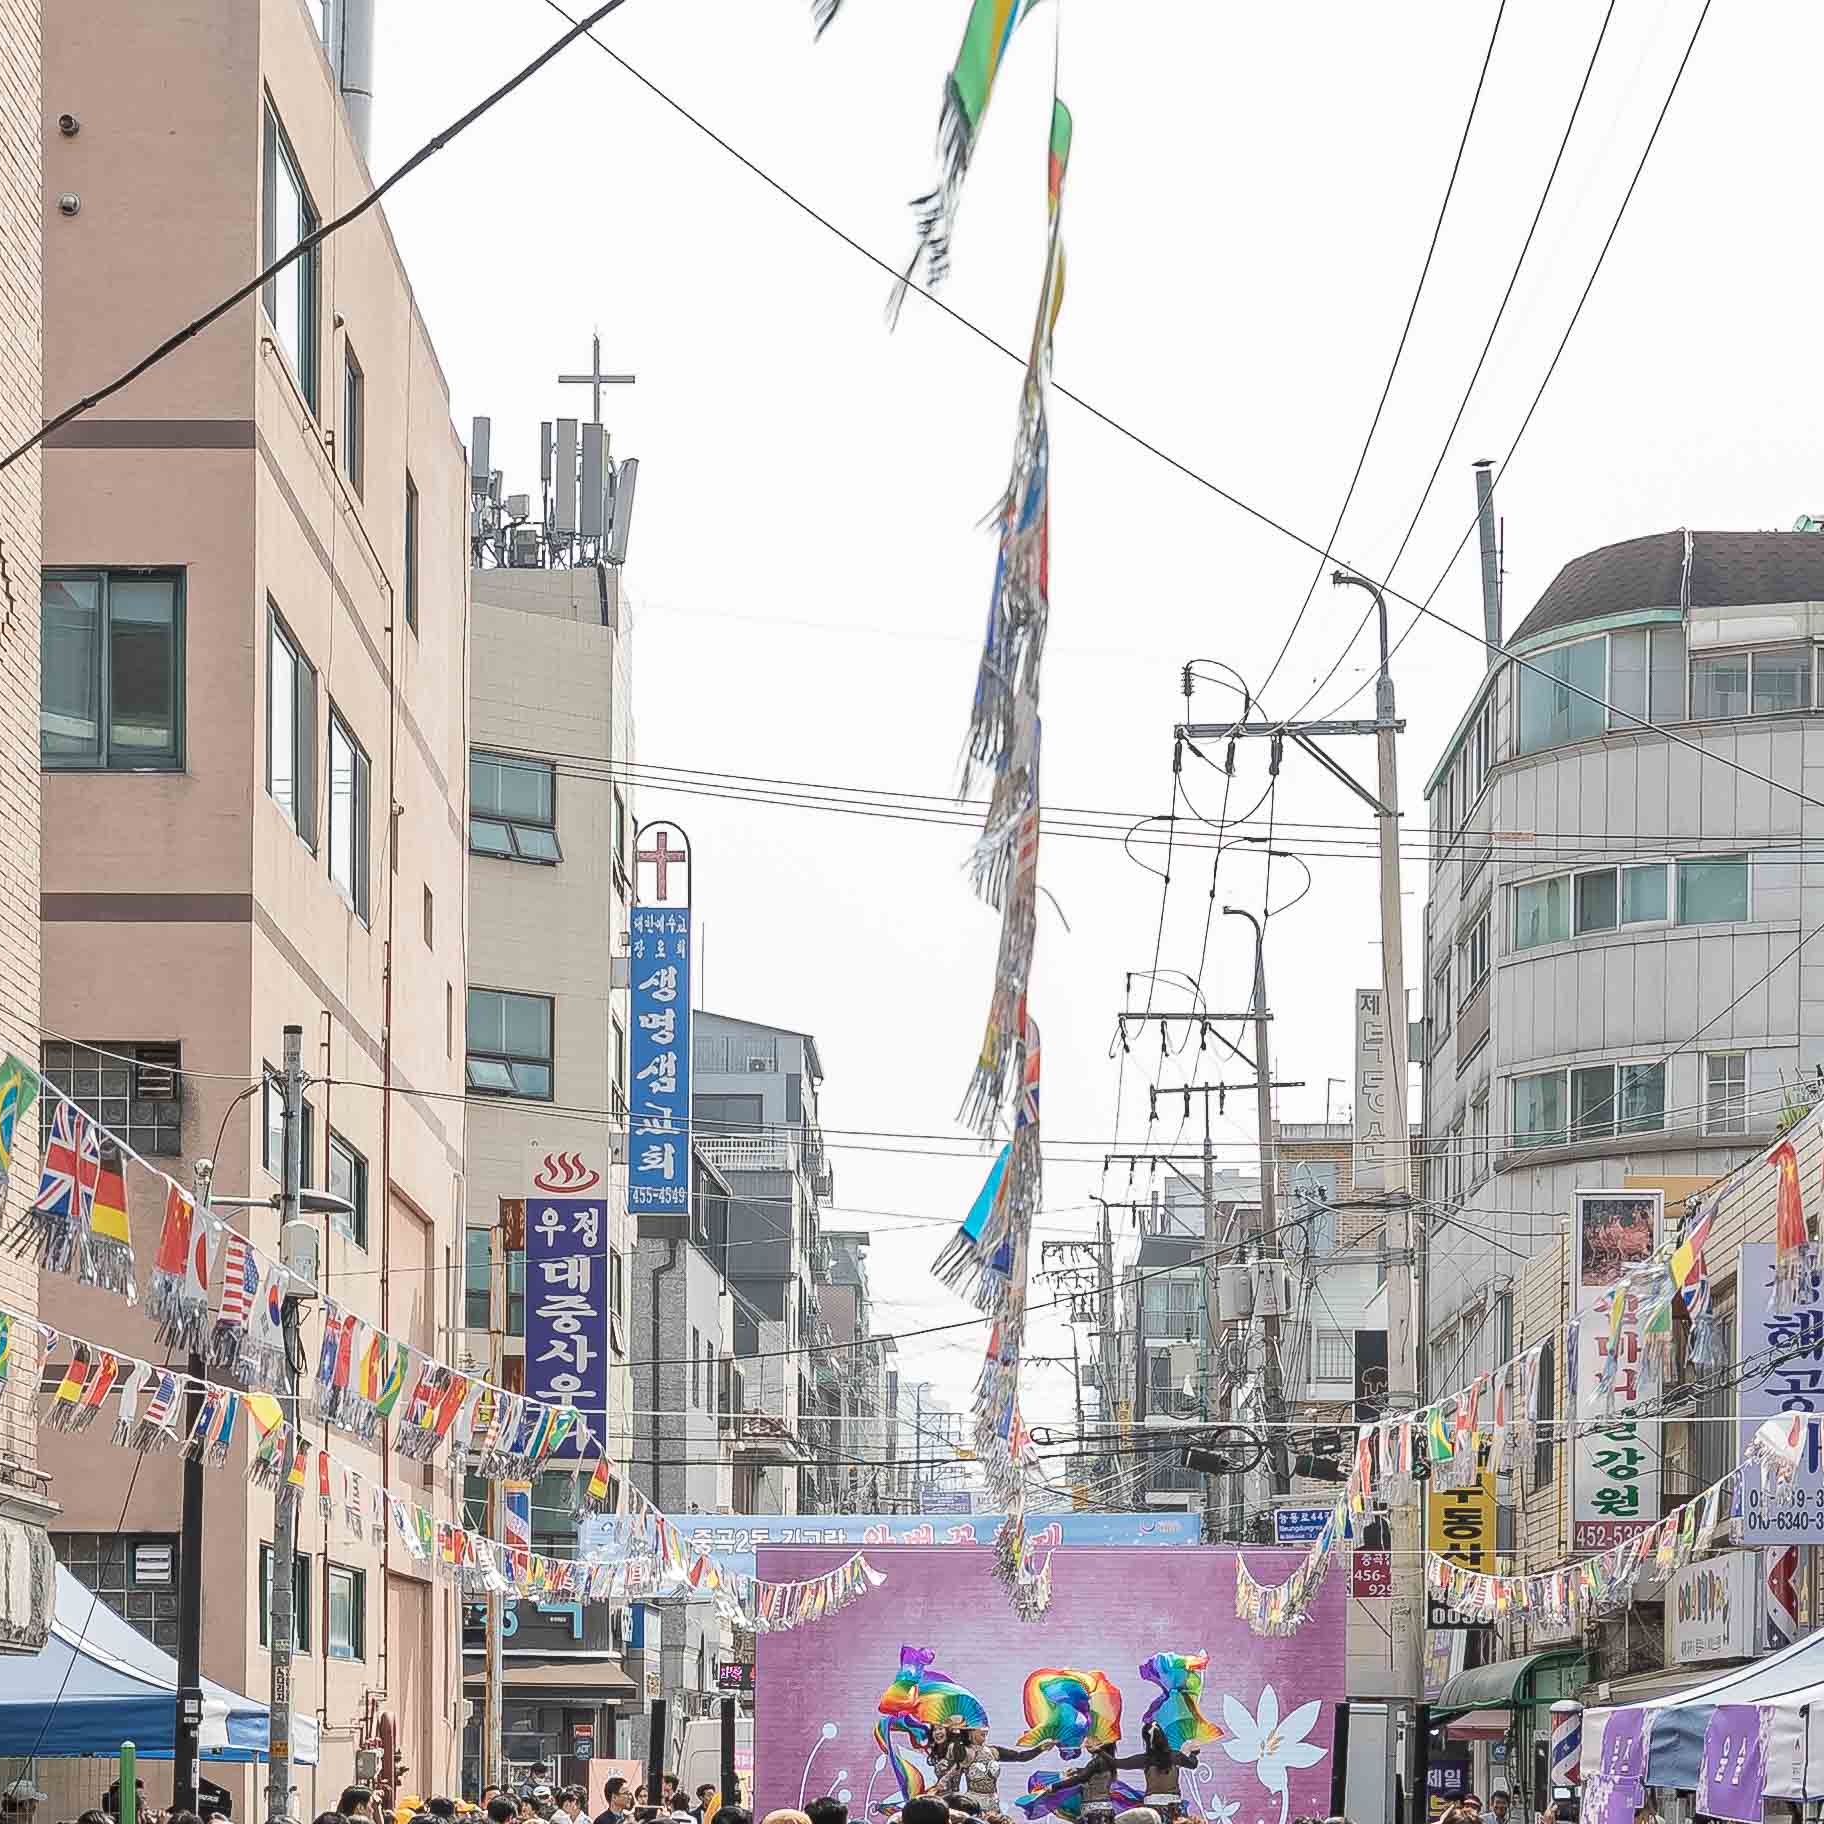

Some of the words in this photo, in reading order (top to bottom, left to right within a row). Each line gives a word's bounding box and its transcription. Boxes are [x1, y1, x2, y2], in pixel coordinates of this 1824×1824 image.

[635, 966, 681, 1180] 생명샘교회
[632, 1186, 686, 1204] 455-4549
[534, 1207, 599, 1248] 우정
[1576, 1524, 1649, 1547] 452-53
